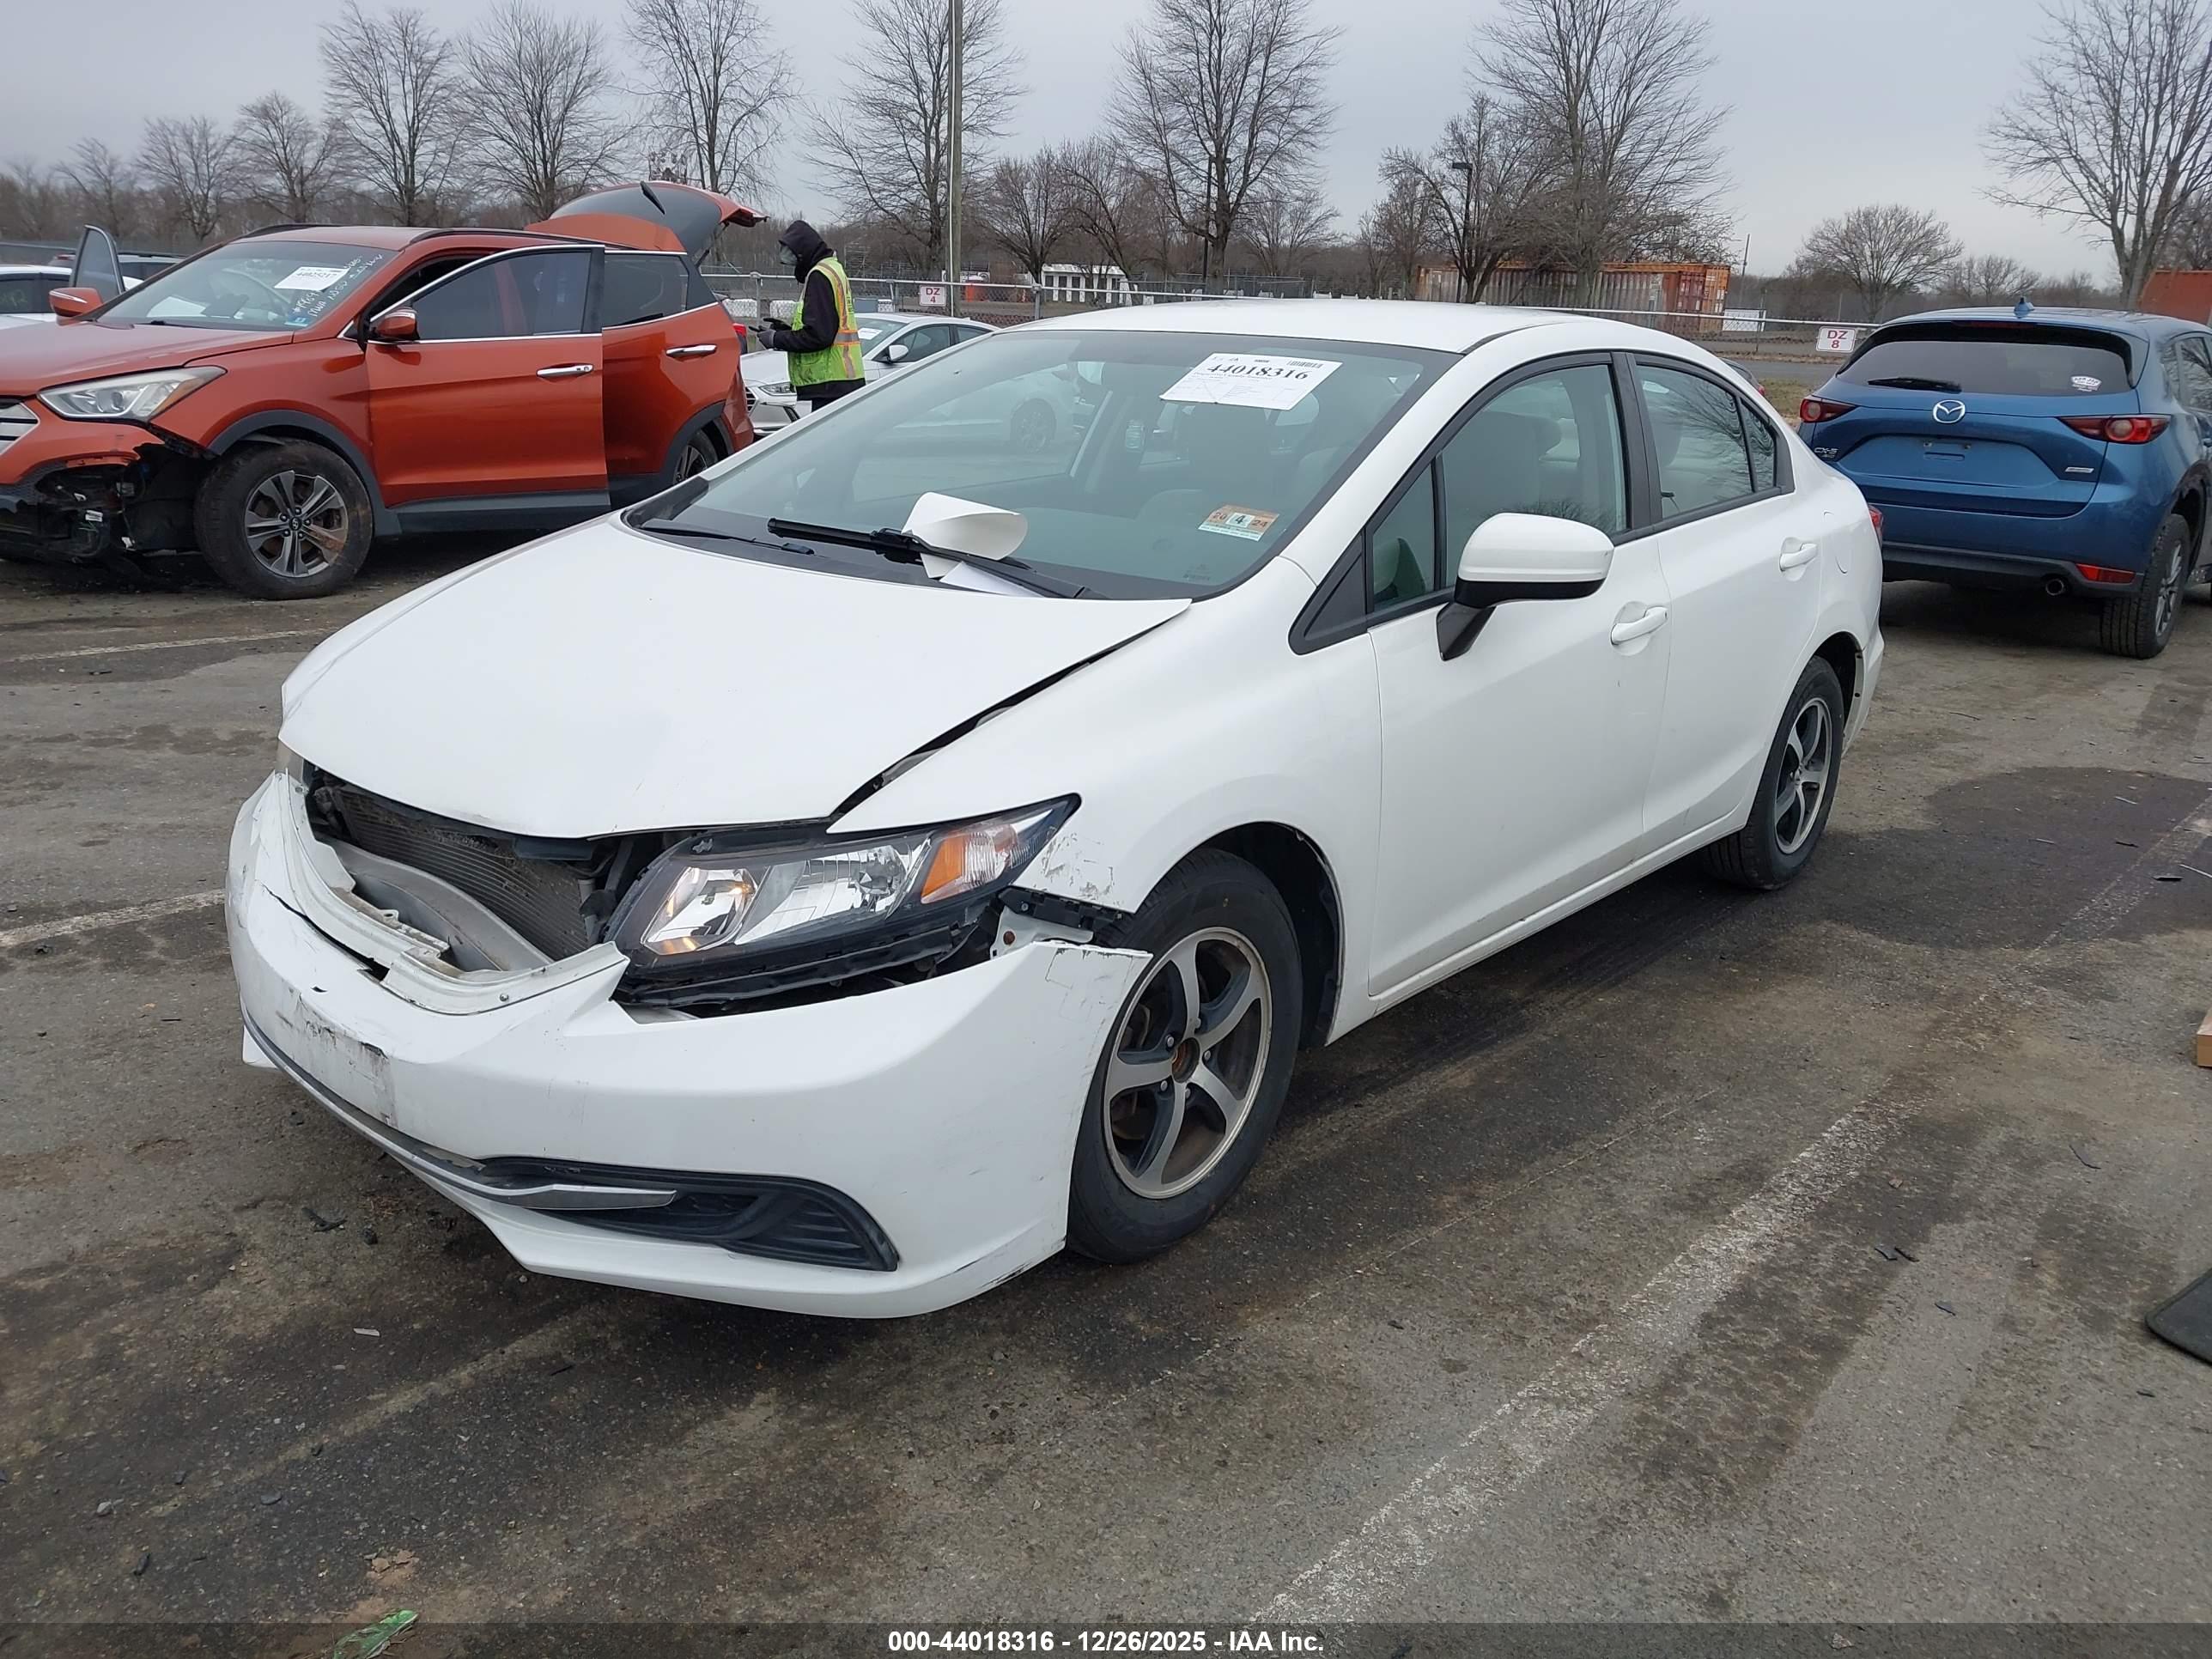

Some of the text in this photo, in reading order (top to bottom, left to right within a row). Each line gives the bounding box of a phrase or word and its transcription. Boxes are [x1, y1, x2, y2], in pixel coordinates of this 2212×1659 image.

[1827, 330, 1848, 339] DZ
[1206, 363, 1313, 380] 44018316
[1235, 515, 1245, 524] 4
